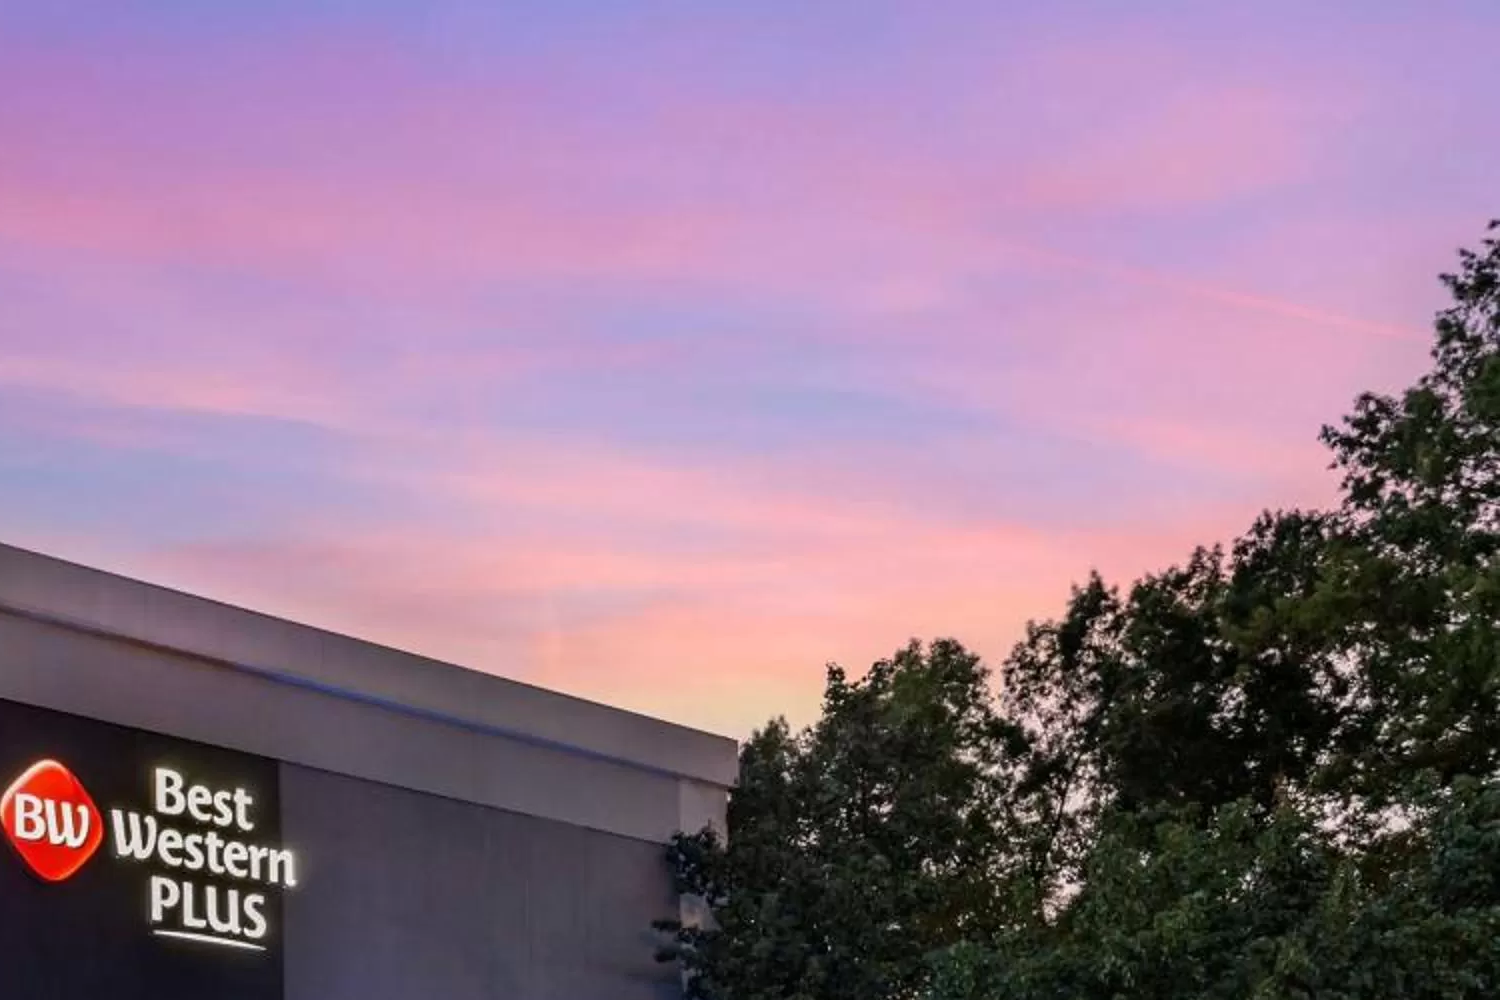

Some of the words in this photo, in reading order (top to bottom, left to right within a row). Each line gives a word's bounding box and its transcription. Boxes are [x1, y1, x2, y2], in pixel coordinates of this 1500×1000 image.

[14, 793, 89, 848] BW
[155, 767, 254, 831] Best
[111, 808, 297, 887] Western
[150, 875, 267, 939] PLUS
